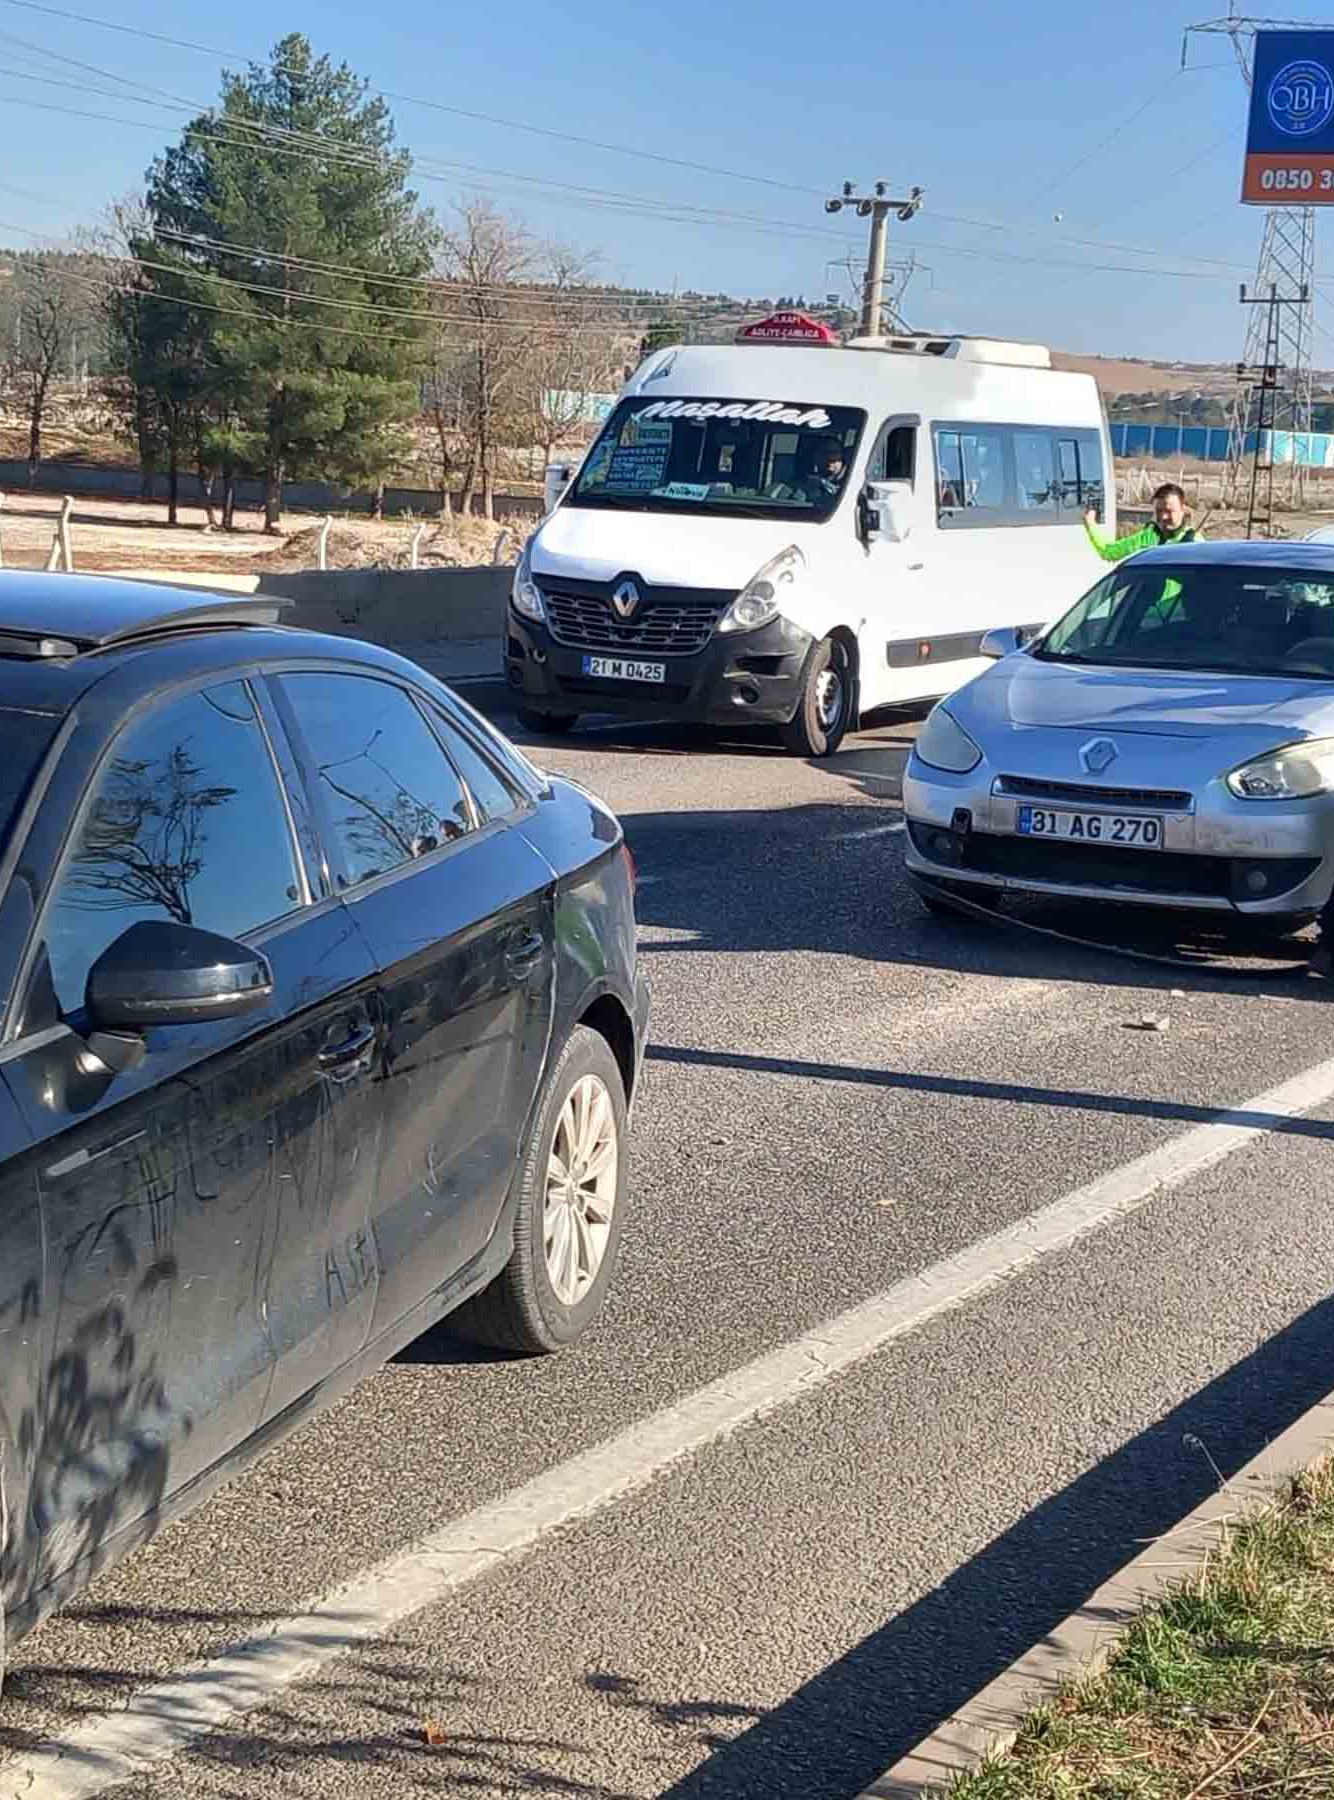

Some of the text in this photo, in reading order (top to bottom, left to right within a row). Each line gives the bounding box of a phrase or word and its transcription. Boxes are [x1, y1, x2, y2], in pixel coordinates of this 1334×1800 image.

[1261, 169, 1312, 190] 0850
[637, 400, 832, 428] Maşallah
[591, 659, 662, 681] 21 M 0425
[1032, 811, 1057, 834] 31
[1069, 814, 1102, 838] AG
[1112, 818, 1158, 843] 270
